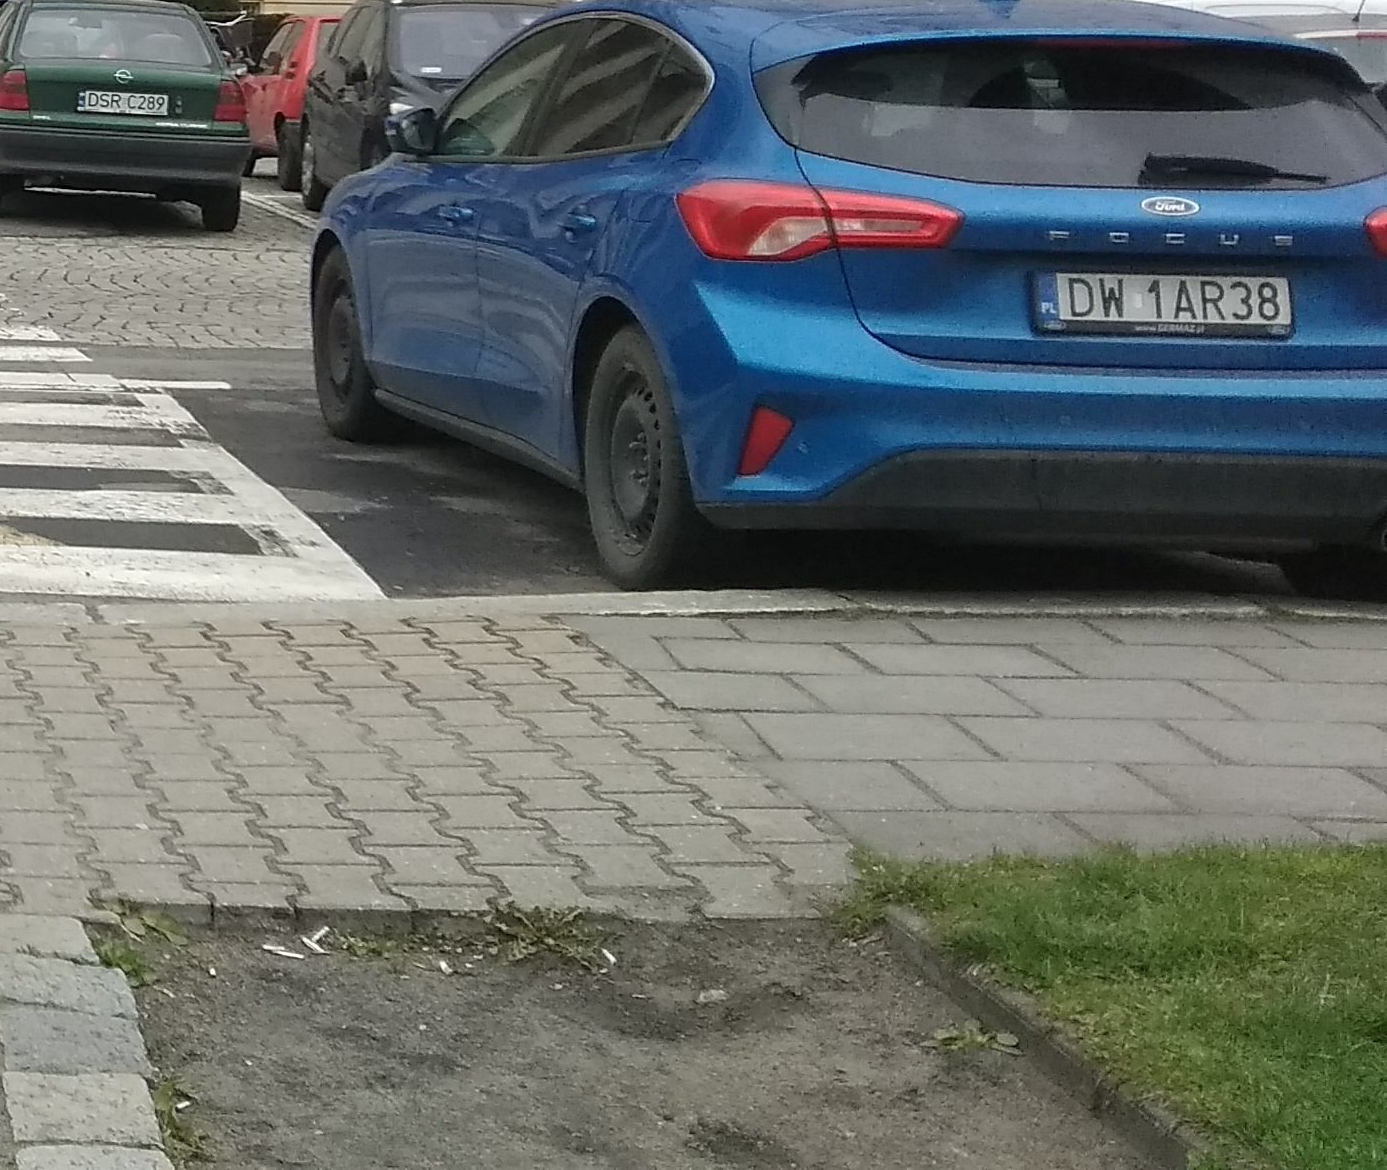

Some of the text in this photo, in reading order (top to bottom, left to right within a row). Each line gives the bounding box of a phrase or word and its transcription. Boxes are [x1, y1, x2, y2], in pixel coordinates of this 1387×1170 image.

[87, 92, 166, 111] DSR C289
[1154, 200, 1186, 212] Ford
[1048, 229, 1294, 247] FOCUS
[1041, 302, 1057, 315] PL
[1067, 277, 1281, 322] DW 1AR38
